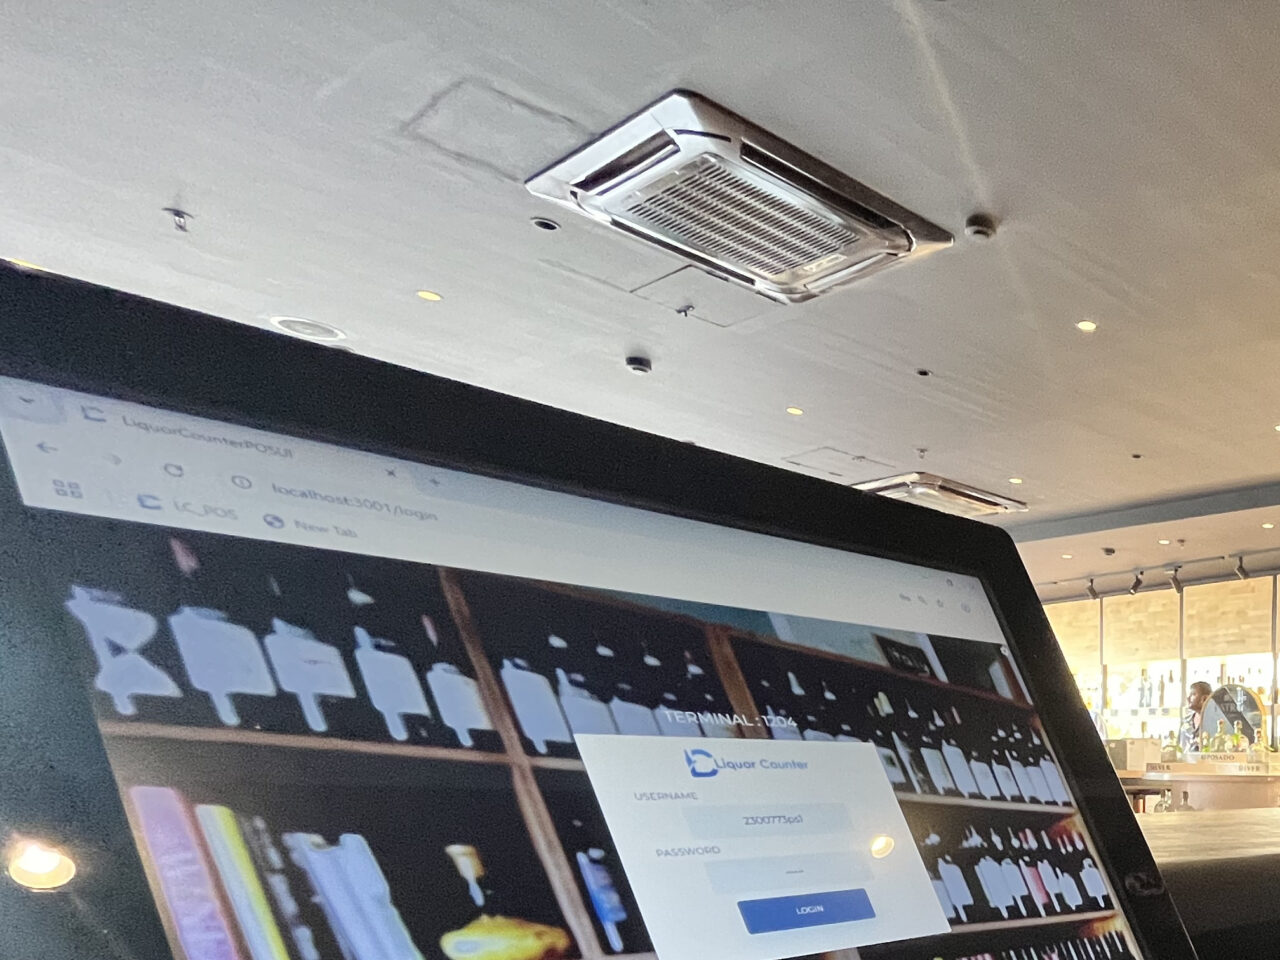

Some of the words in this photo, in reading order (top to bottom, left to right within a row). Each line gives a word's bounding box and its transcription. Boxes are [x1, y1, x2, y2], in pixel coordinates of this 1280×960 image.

[664, 710, 753, 727] TERMINAL
[714, 757, 756, 771] Liquor
[760, 758, 808, 770] Counter
[634, 791, 699, 801] USERNAME
[655, 845, 722, 858] PASSWORD
[796, 903, 824, 916] LOGIN
